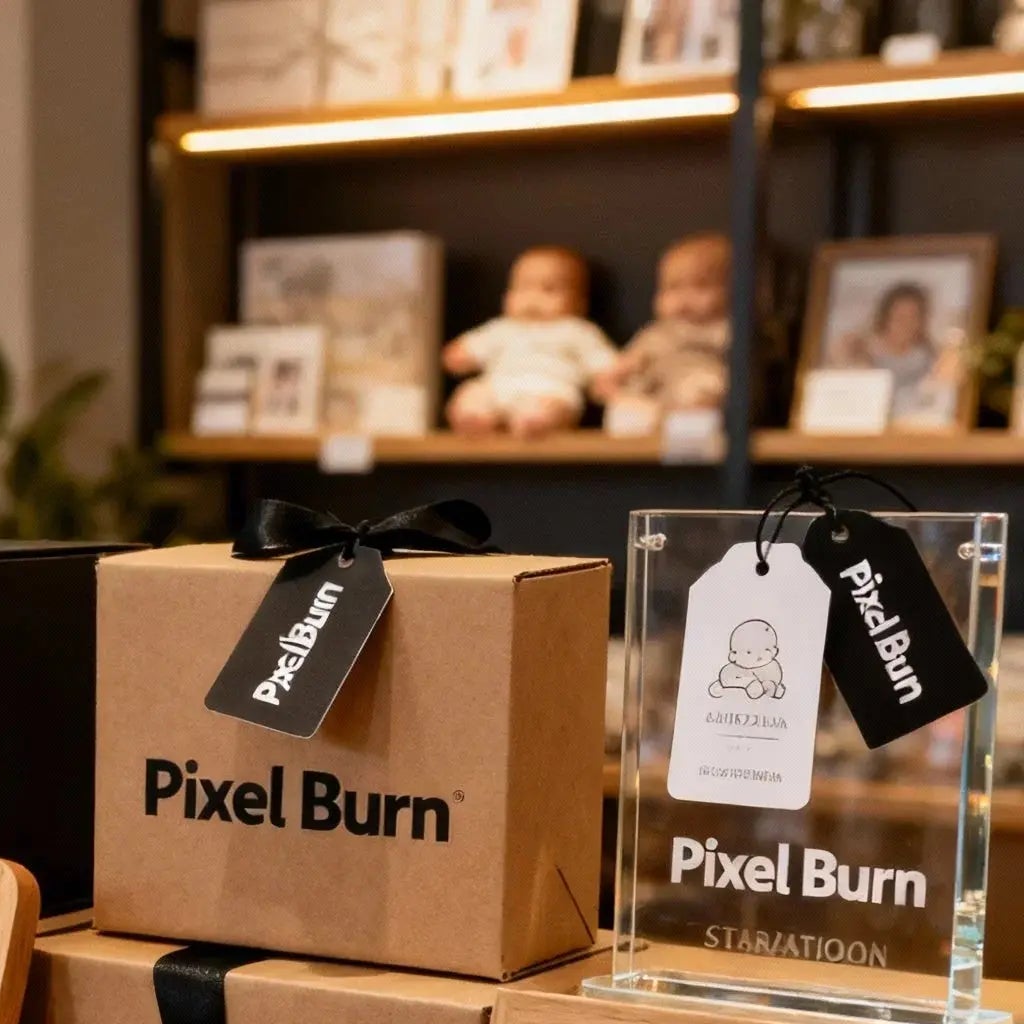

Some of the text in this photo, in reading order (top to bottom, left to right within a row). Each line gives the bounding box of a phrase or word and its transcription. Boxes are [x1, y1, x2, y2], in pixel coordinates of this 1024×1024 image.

[145, 758, 450, 843] Pixel Burn
[670, 836, 927, 908] Pixel Burn
